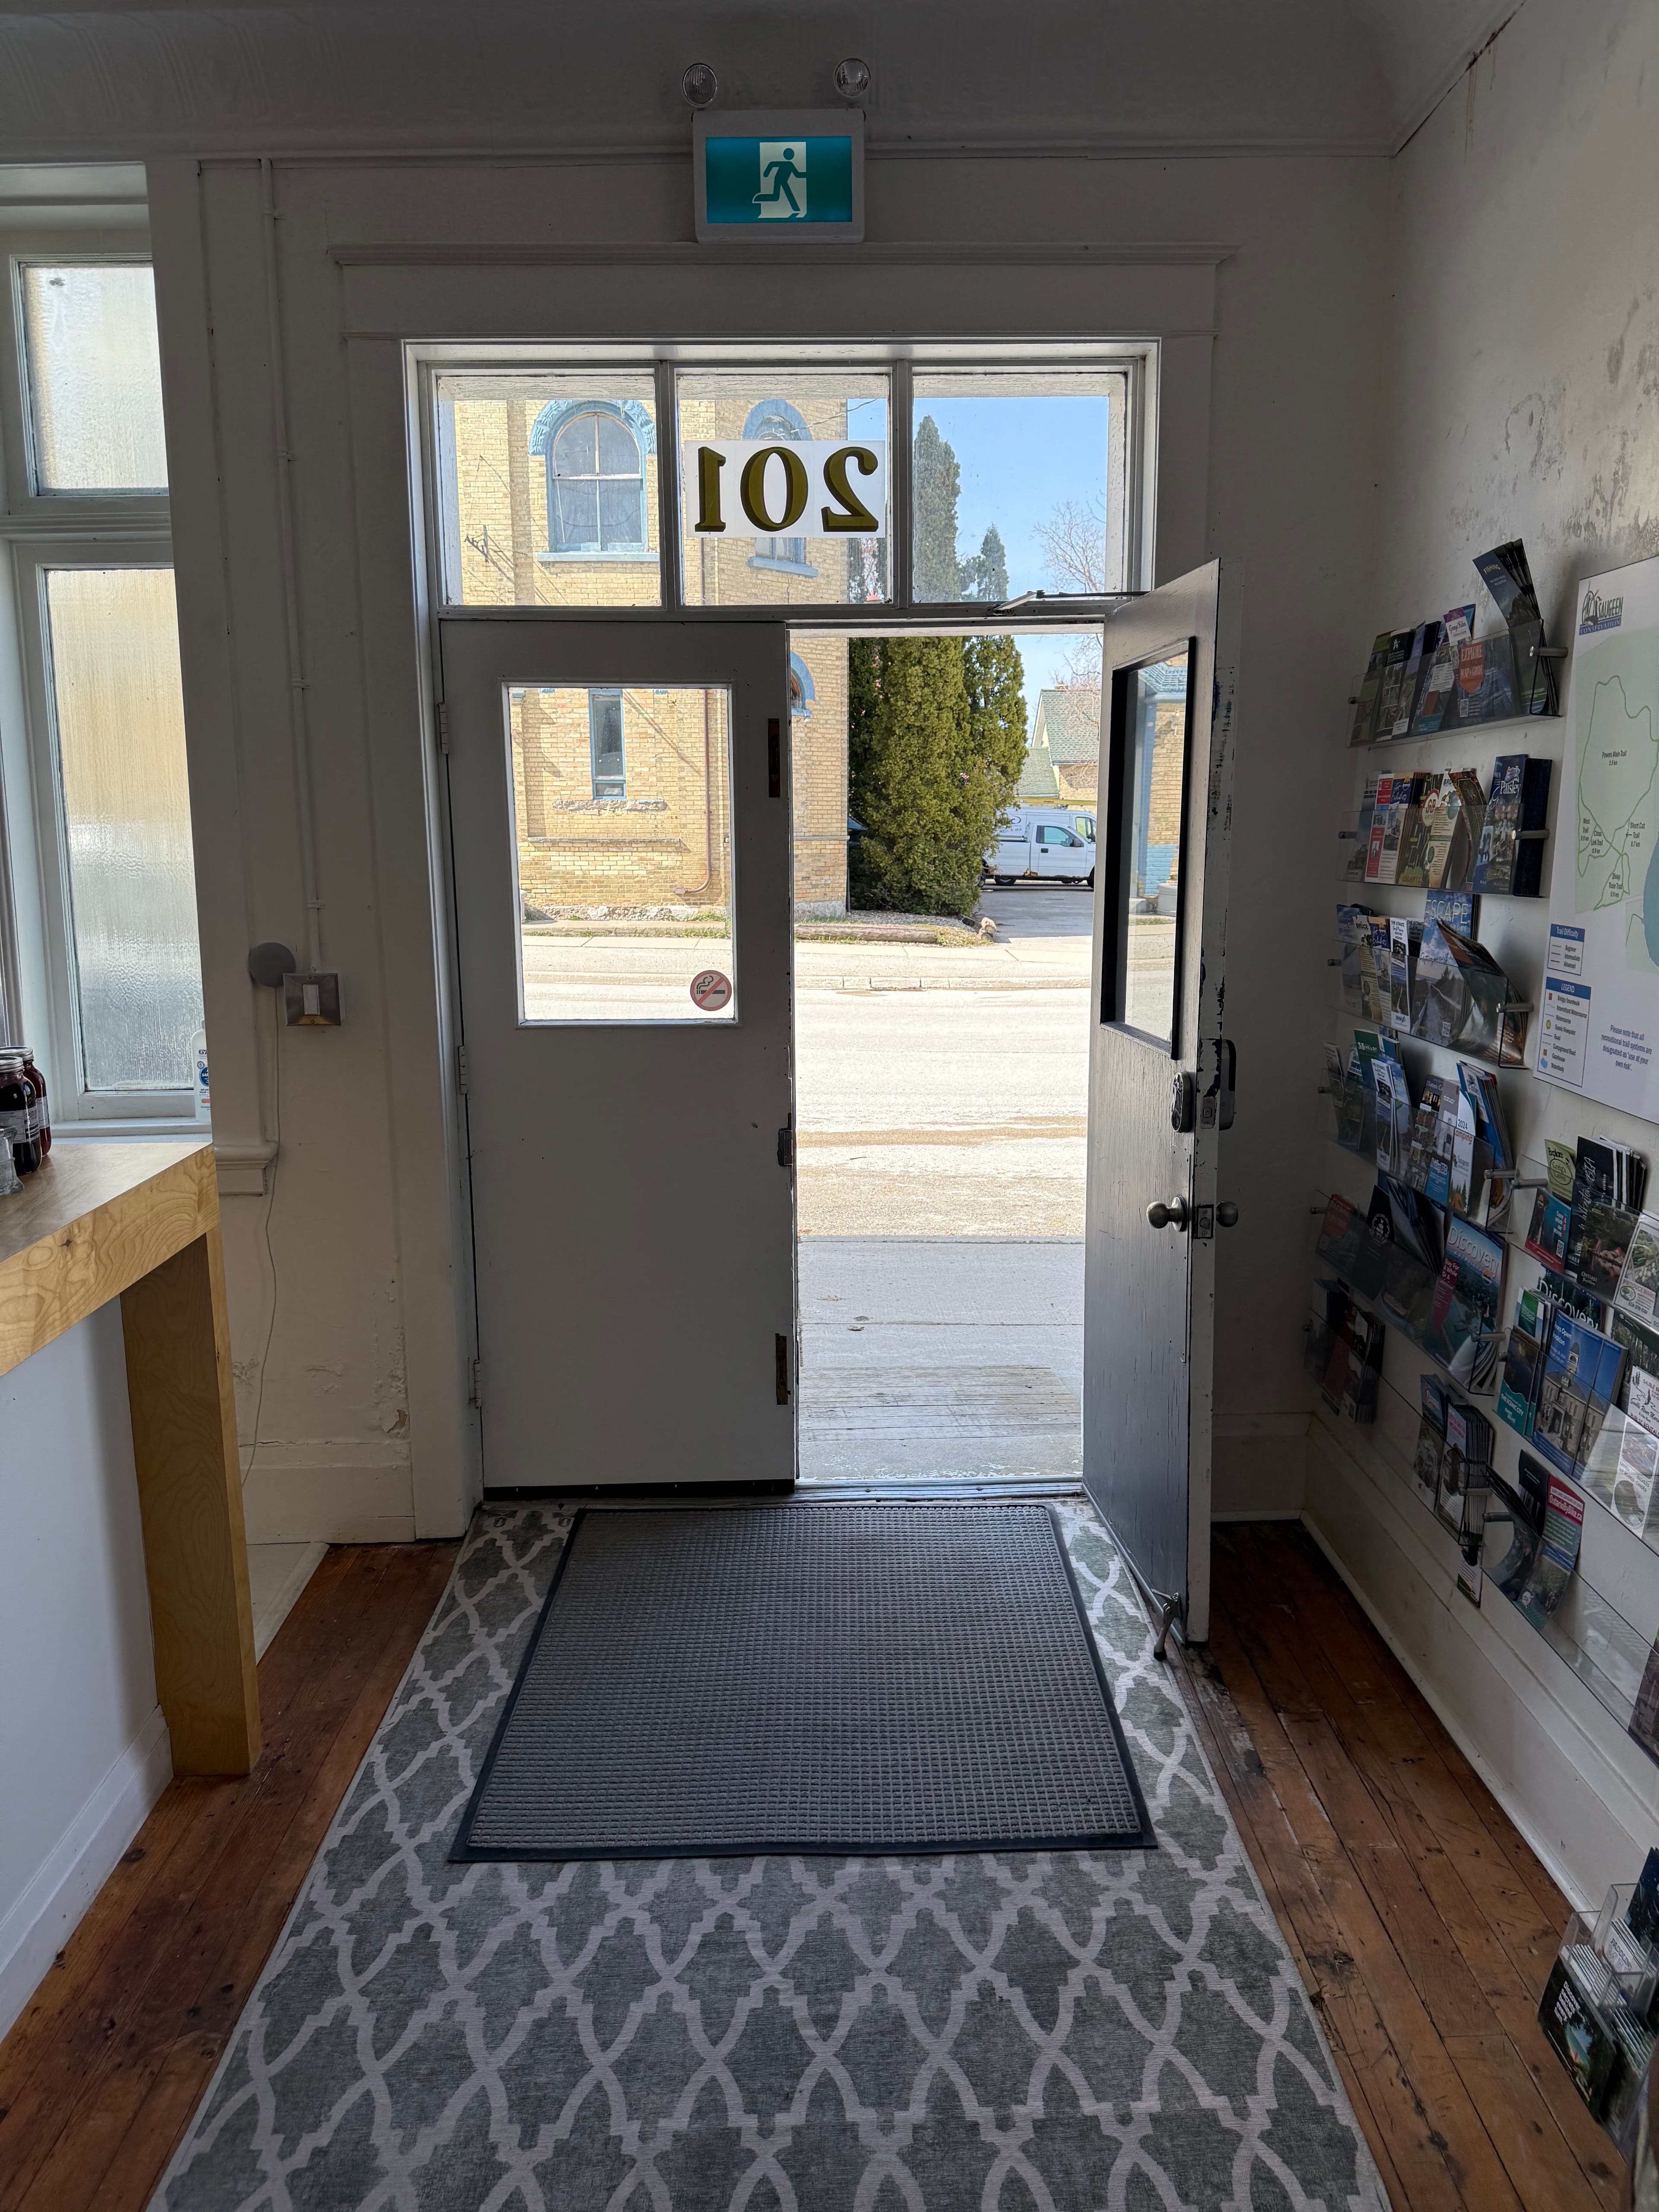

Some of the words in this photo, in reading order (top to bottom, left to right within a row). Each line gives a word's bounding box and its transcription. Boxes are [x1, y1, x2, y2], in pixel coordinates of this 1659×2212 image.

[1483, 564, 1501, 574] FISHING
[1598, 596, 1624, 619] SAUGEEN
[1580, 620, 1621, 634] CONSERVATION
[1461, 645, 1483, 662] EXPLORE
[1500, 780, 1521, 798] Paisley
[1564, 928, 1579, 939] Difficulty
[1561, 983, 1575, 993] LEGEND
[1610, 1024, 1622, 1034] Please
[1601, 1035, 1622, 1045] recreational
[1630, 1043, 1645, 1052] systems
[1602, 1045, 1622, 1056] designated
[1458, 1119, 1468, 1129] 2024
[1455, 1129, 1473, 1144] amping
[1548, 1147, 1564, 1160] Explore
[1583, 1156, 1597, 1182] BIA
[1448, 1227, 1501, 1279] Discovery
[1446, 1265, 1458, 1277] While
[1561, 1328, 1572, 1339] Open
[1506, 1398, 1517, 1411] SCENIC
[1516, 1407, 1524, 1417] CITY
[1549, 1494, 1582, 1521] OntarioByBike.ca
